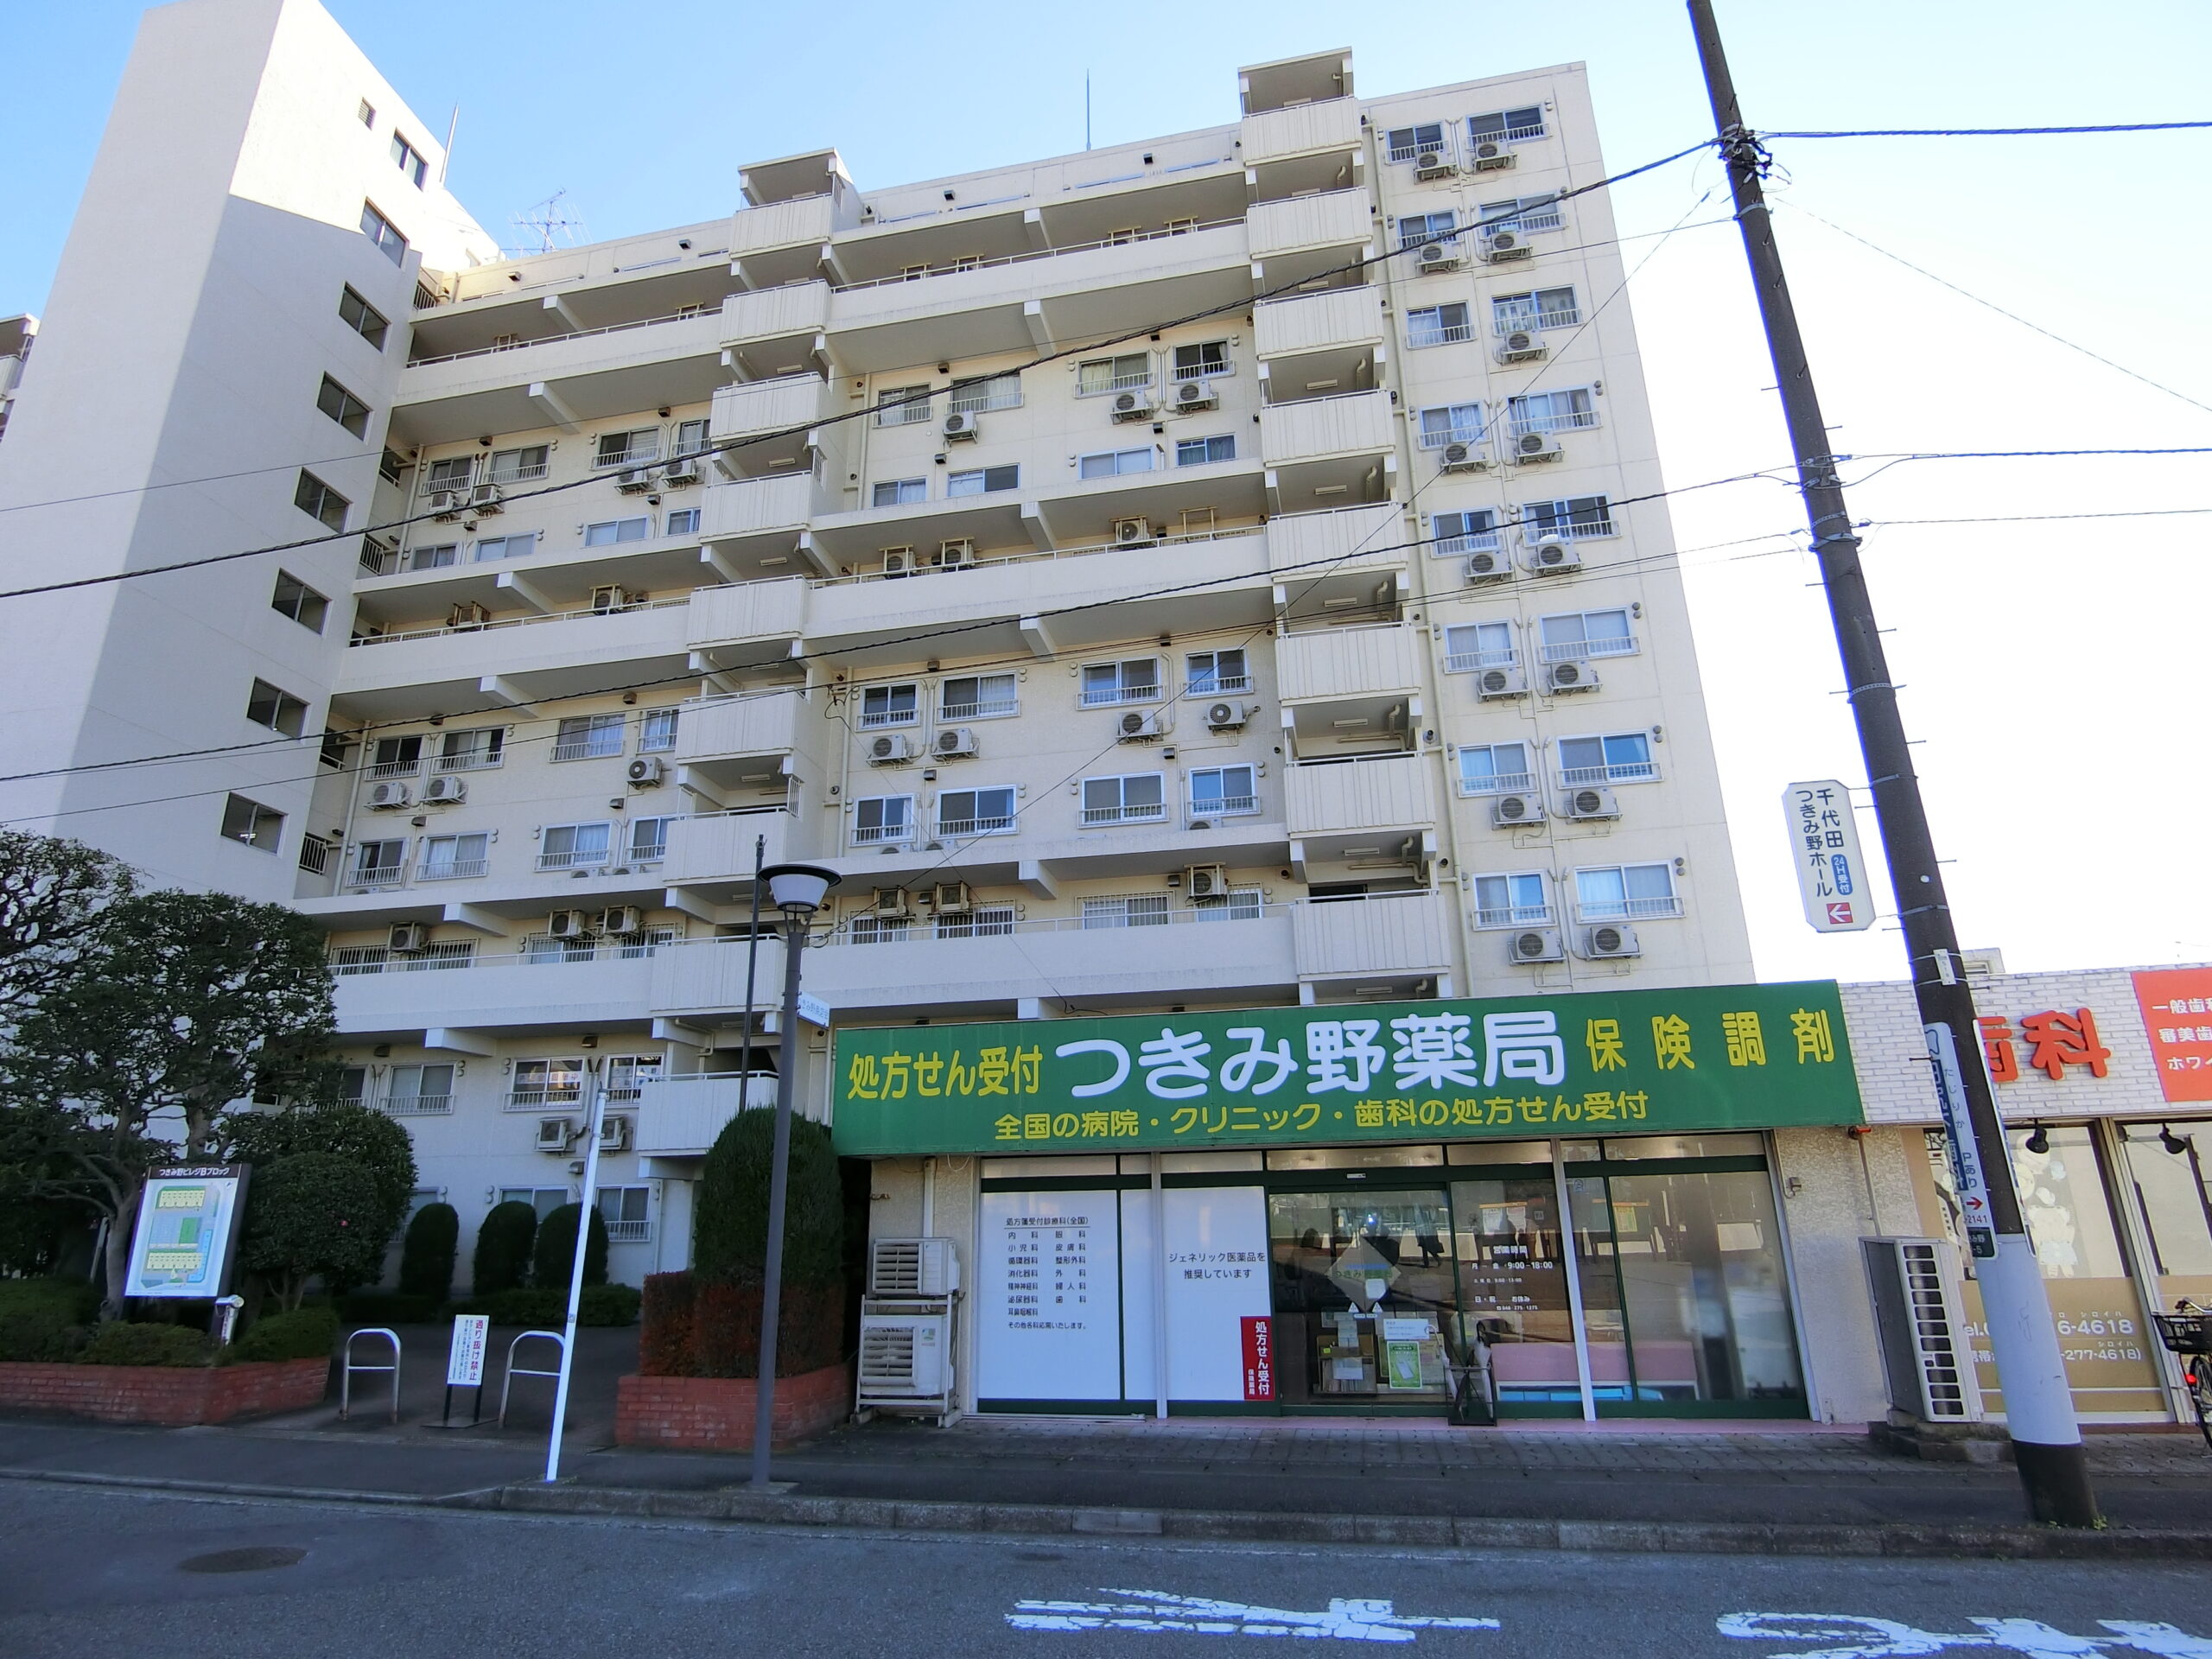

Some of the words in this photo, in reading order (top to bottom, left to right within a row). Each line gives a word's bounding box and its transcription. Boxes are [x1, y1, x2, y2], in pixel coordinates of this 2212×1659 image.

[1796, 789, 1833, 898] つきみ野ホール
[1816, 788, 1845, 849] 千代田
[1833, 856, 1850, 894] 24H受付
[849, 1046, 1043, 1099] 処方せん受付
[1055, 1010, 1565, 1099] つきみ野薬局
[1586, 1007, 1835, 1072] 保険調剤
[995, 1091, 1648, 1140] 全国の病院・クリニック・歯科の処方せん受付
[1007, 1243, 1038, 1252] 小児科
[1055, 1255, 1086, 1264] 整形外科
[1169, 1252, 1266, 1262] ジェネリック医薬品を
[1007, 1269, 1038, 1278] 消化器科
[1184, 1268, 1252, 1279] 推奨しています
[469, 1319, 484, 1381] 通り抜け禁止
[1255, 1321, 1270, 1395] 処方せん受付
